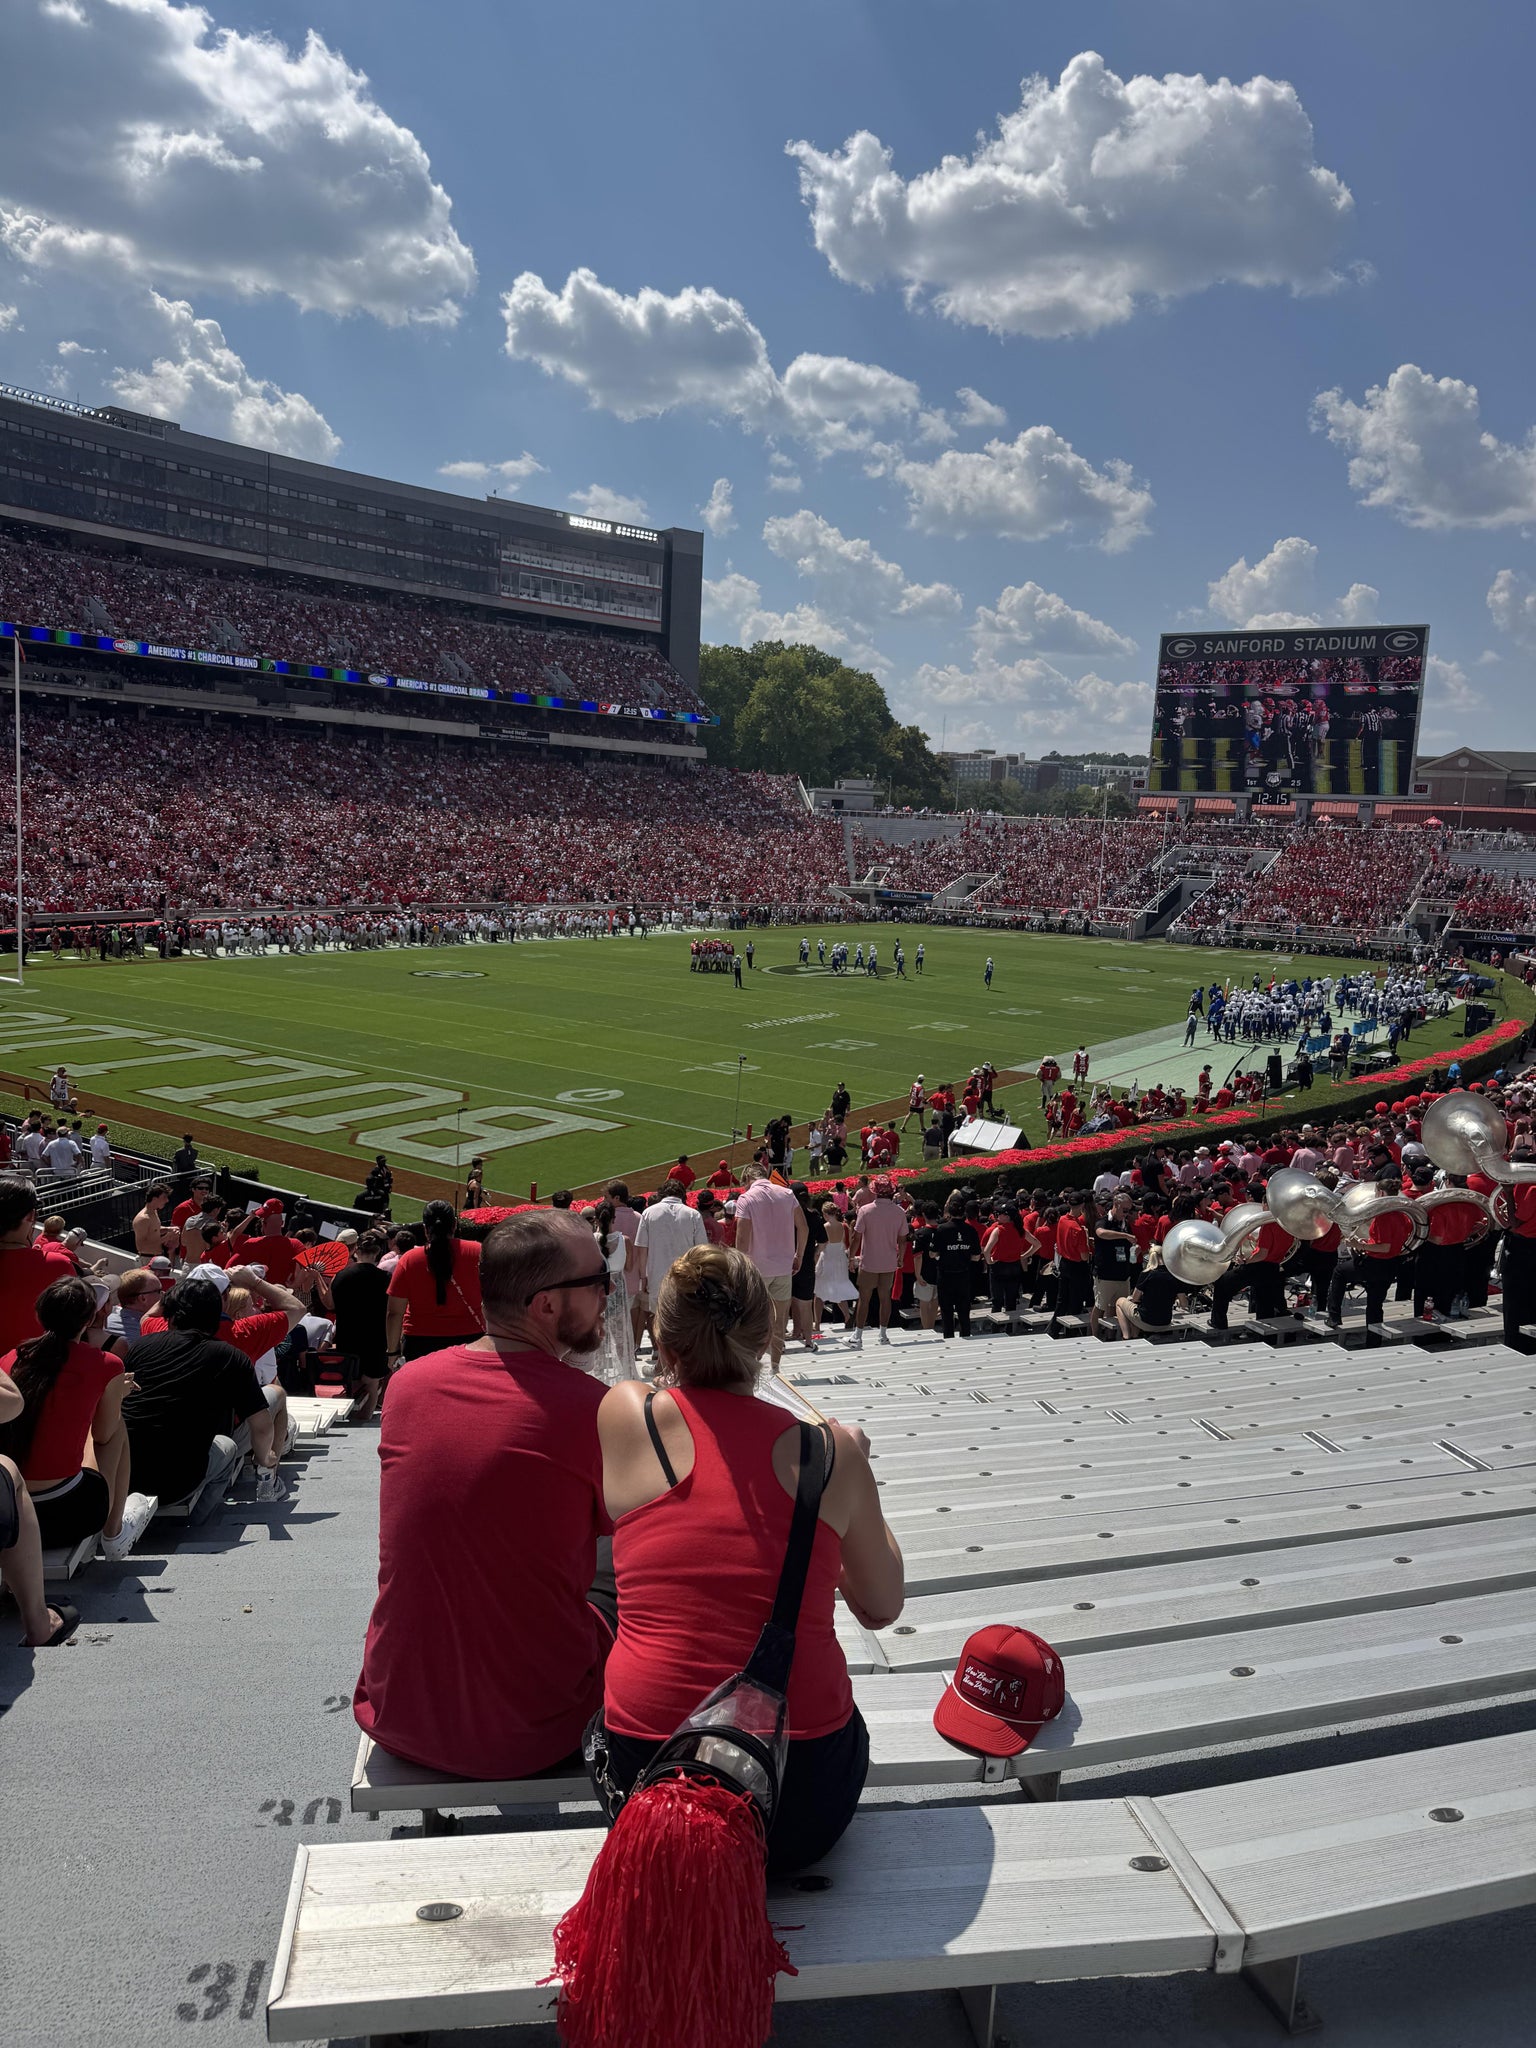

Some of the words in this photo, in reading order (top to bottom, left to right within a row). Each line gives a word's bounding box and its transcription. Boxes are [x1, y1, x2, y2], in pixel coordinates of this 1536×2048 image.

[1203, 639, 1285, 654] SANFORD
[1293, 635, 1377, 651] STADIUM
[148, 645, 186, 659] AMERICA'S
[187, 650, 197, 660] #1
[198, 651, 234, 665] CHARCOAL
[235, 656, 258, 668] BRAND
[396, 678, 429, 690] AMERICA'S
[429, 683, 438, 692] #1
[438, 684, 469, 696] CHARCOAL
[469, 688, 489, 698] BRAND
[1290, 779, 1302, 787] 25
[1257, 793, 1288, 805] 12:15
[176, 1960, 266, 2022] 31
